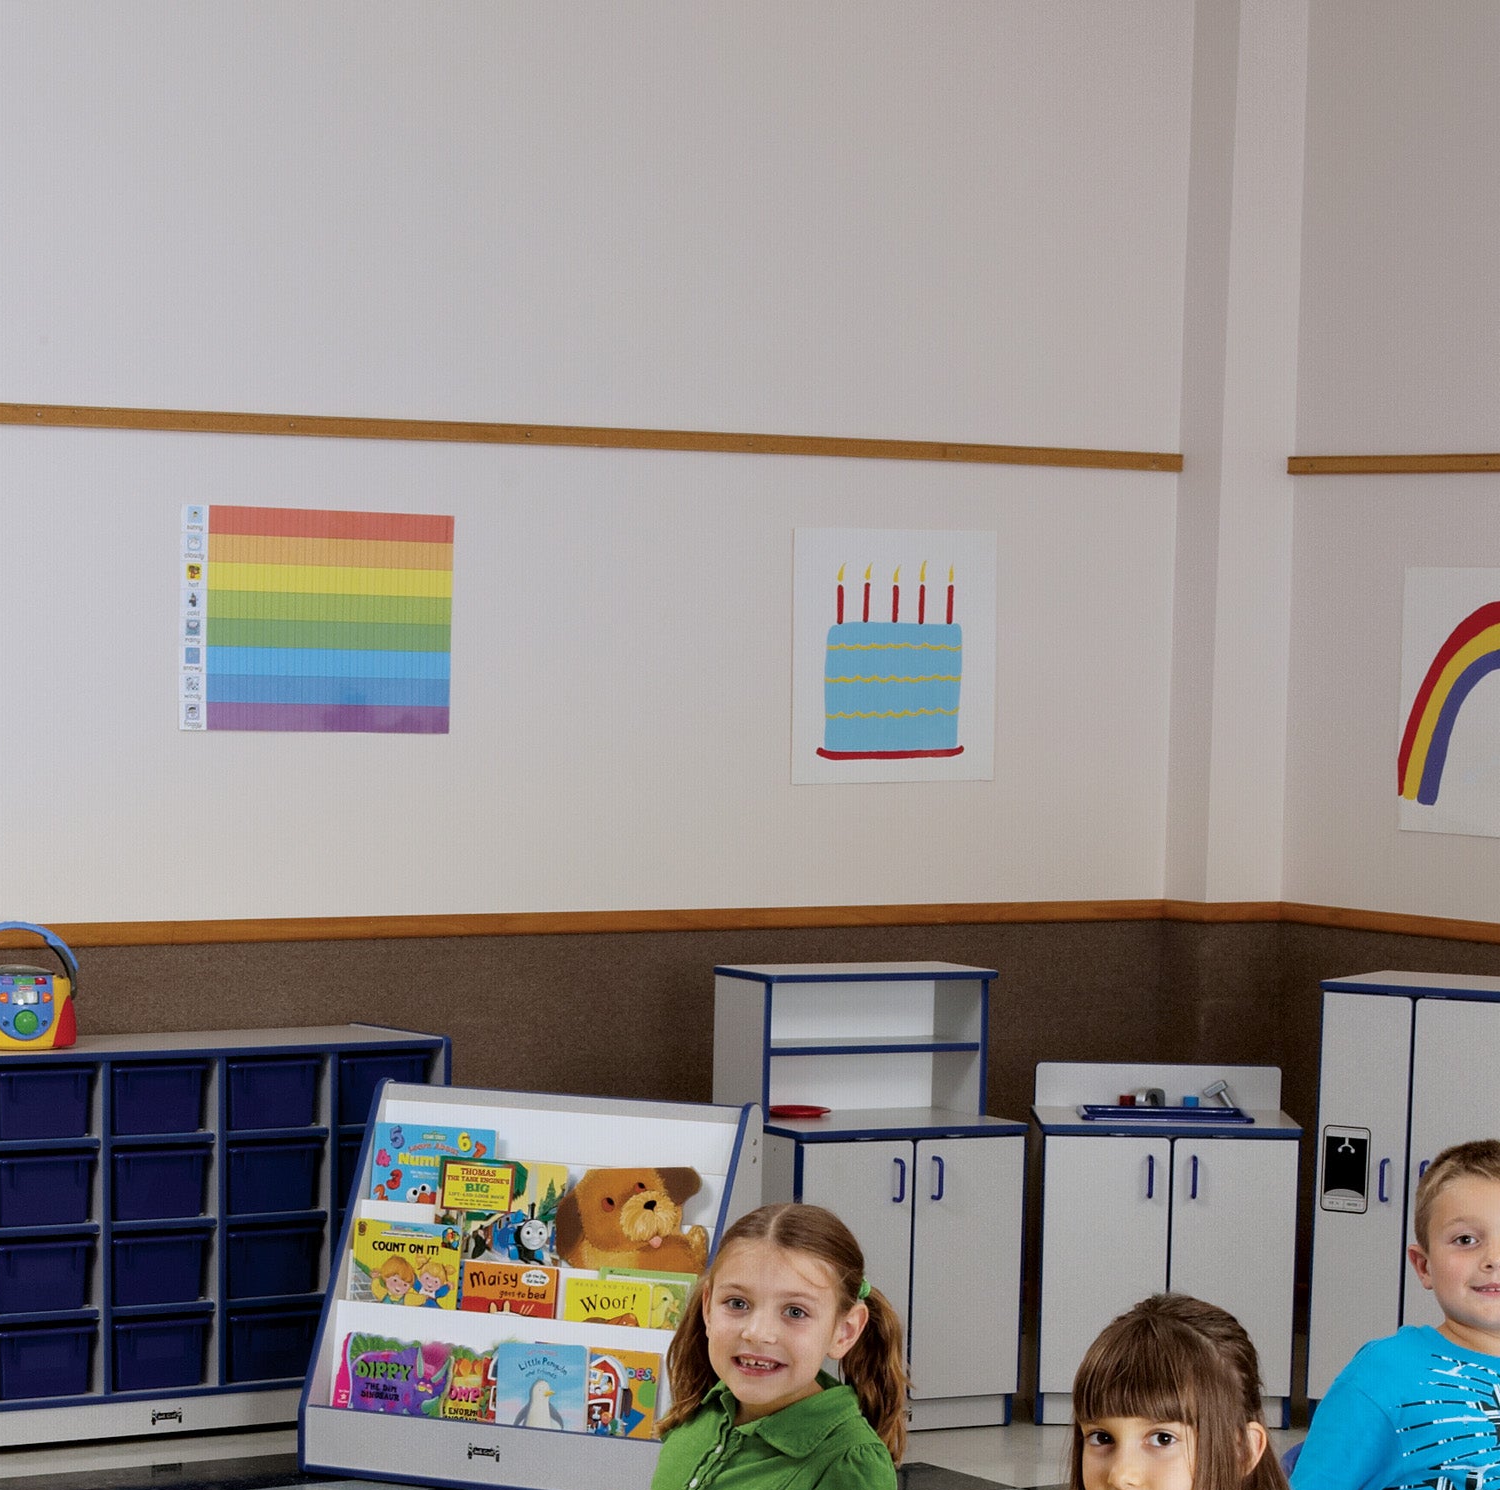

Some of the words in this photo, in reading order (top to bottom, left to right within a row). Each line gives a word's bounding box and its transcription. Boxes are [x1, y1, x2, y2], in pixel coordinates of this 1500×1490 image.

[389, 1125, 405, 1150] 5
[457, 1131, 473, 1152] 6
[386, 1169, 403, 1190] 3
[460, 1167, 497, 1177] THOMAS
[465, 1182, 490, 1193] BIG
[372, 1240, 406, 1253] COUNT
[408, 1243, 425, 1254] ON
[426, 1243, 439, 1256] IT!
[469, 1270, 518, 1288] Maisy
[517, 1290, 526, 1299] to
[527, 1288, 547, 1300] bed
[355, 1359, 413, 1382] DIPPY
[517, 1357, 542, 1371] Little
[365, 1382, 381, 1391] THE
[360, 1391, 400, 1401] DINOSAUR
